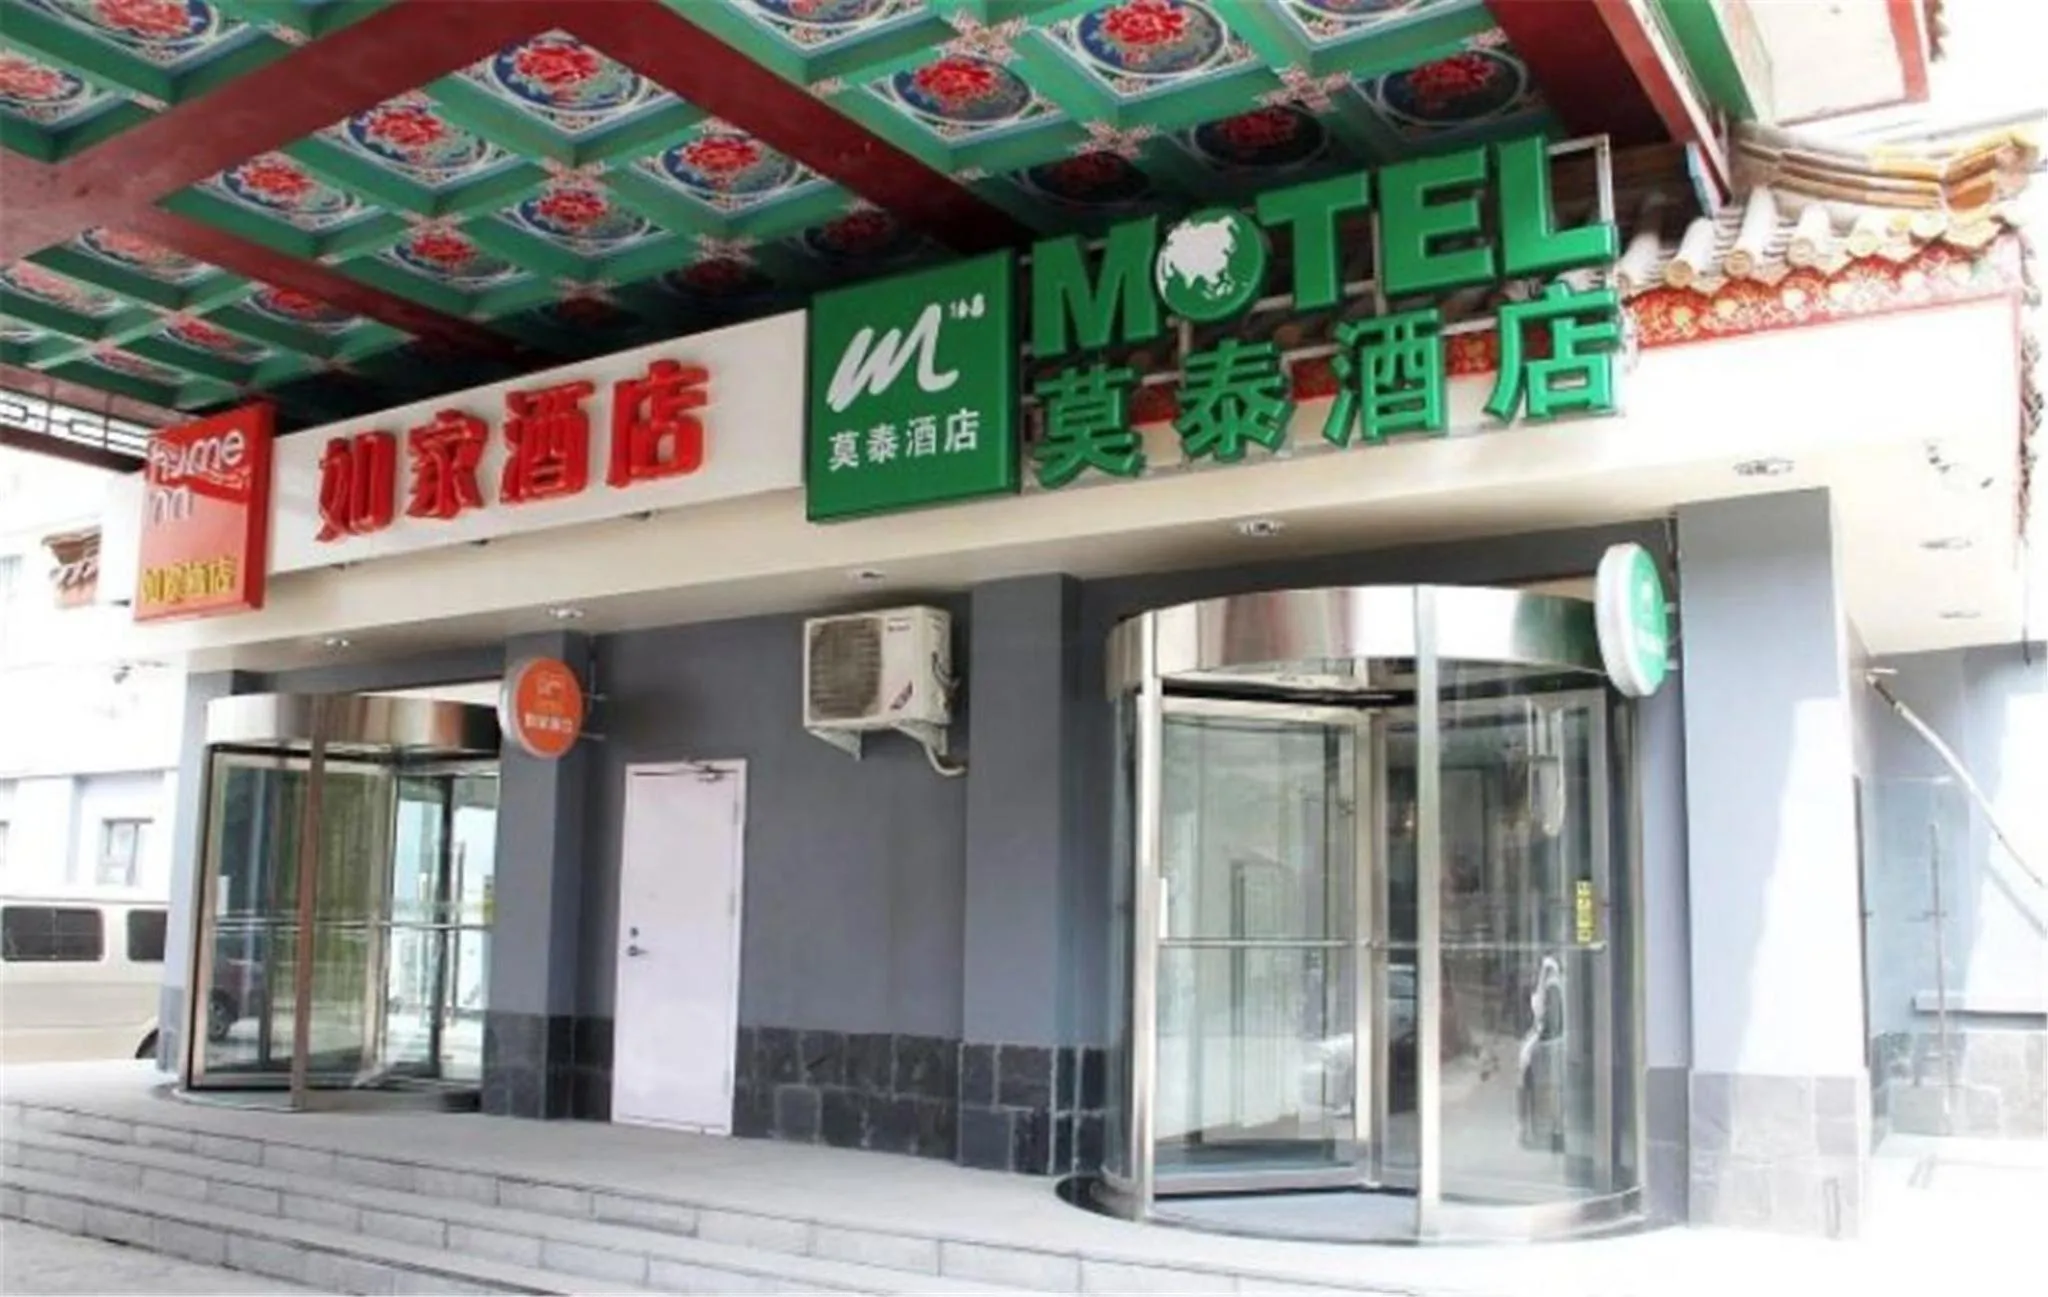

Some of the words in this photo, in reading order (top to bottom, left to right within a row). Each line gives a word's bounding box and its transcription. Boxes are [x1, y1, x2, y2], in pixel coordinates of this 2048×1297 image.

[1030, 136, 1616, 362] MOTEL
[316, 359, 709, 542] 如家酒店
[828, 407, 980, 472] 莫泰酒店
[1032, 282, 1617, 489] 莫泰酒店
